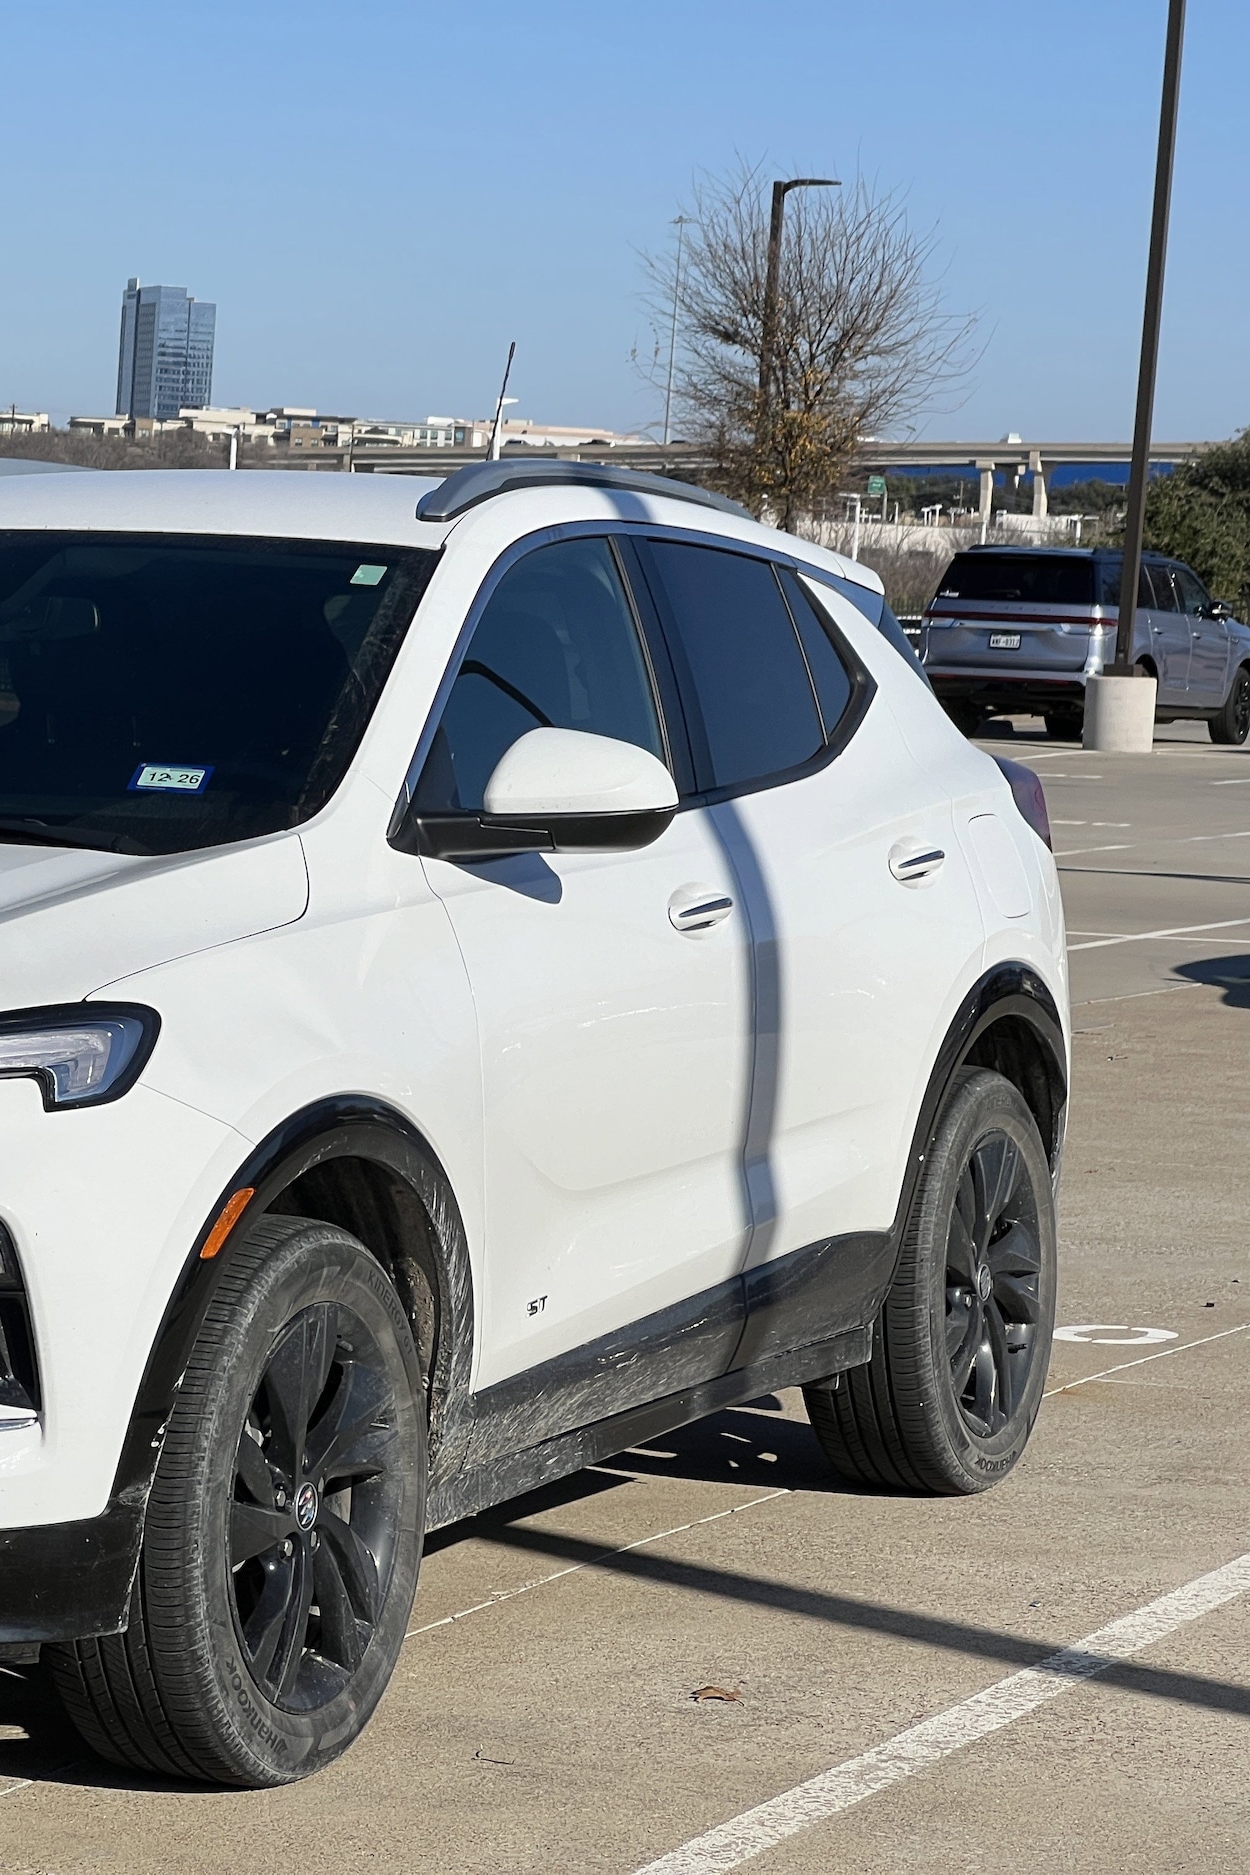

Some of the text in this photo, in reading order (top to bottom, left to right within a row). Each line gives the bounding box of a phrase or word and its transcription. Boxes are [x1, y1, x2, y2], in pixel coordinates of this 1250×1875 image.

[149, 772, 201, 784] 12 26
[526, 1294, 548, 1318] ST
